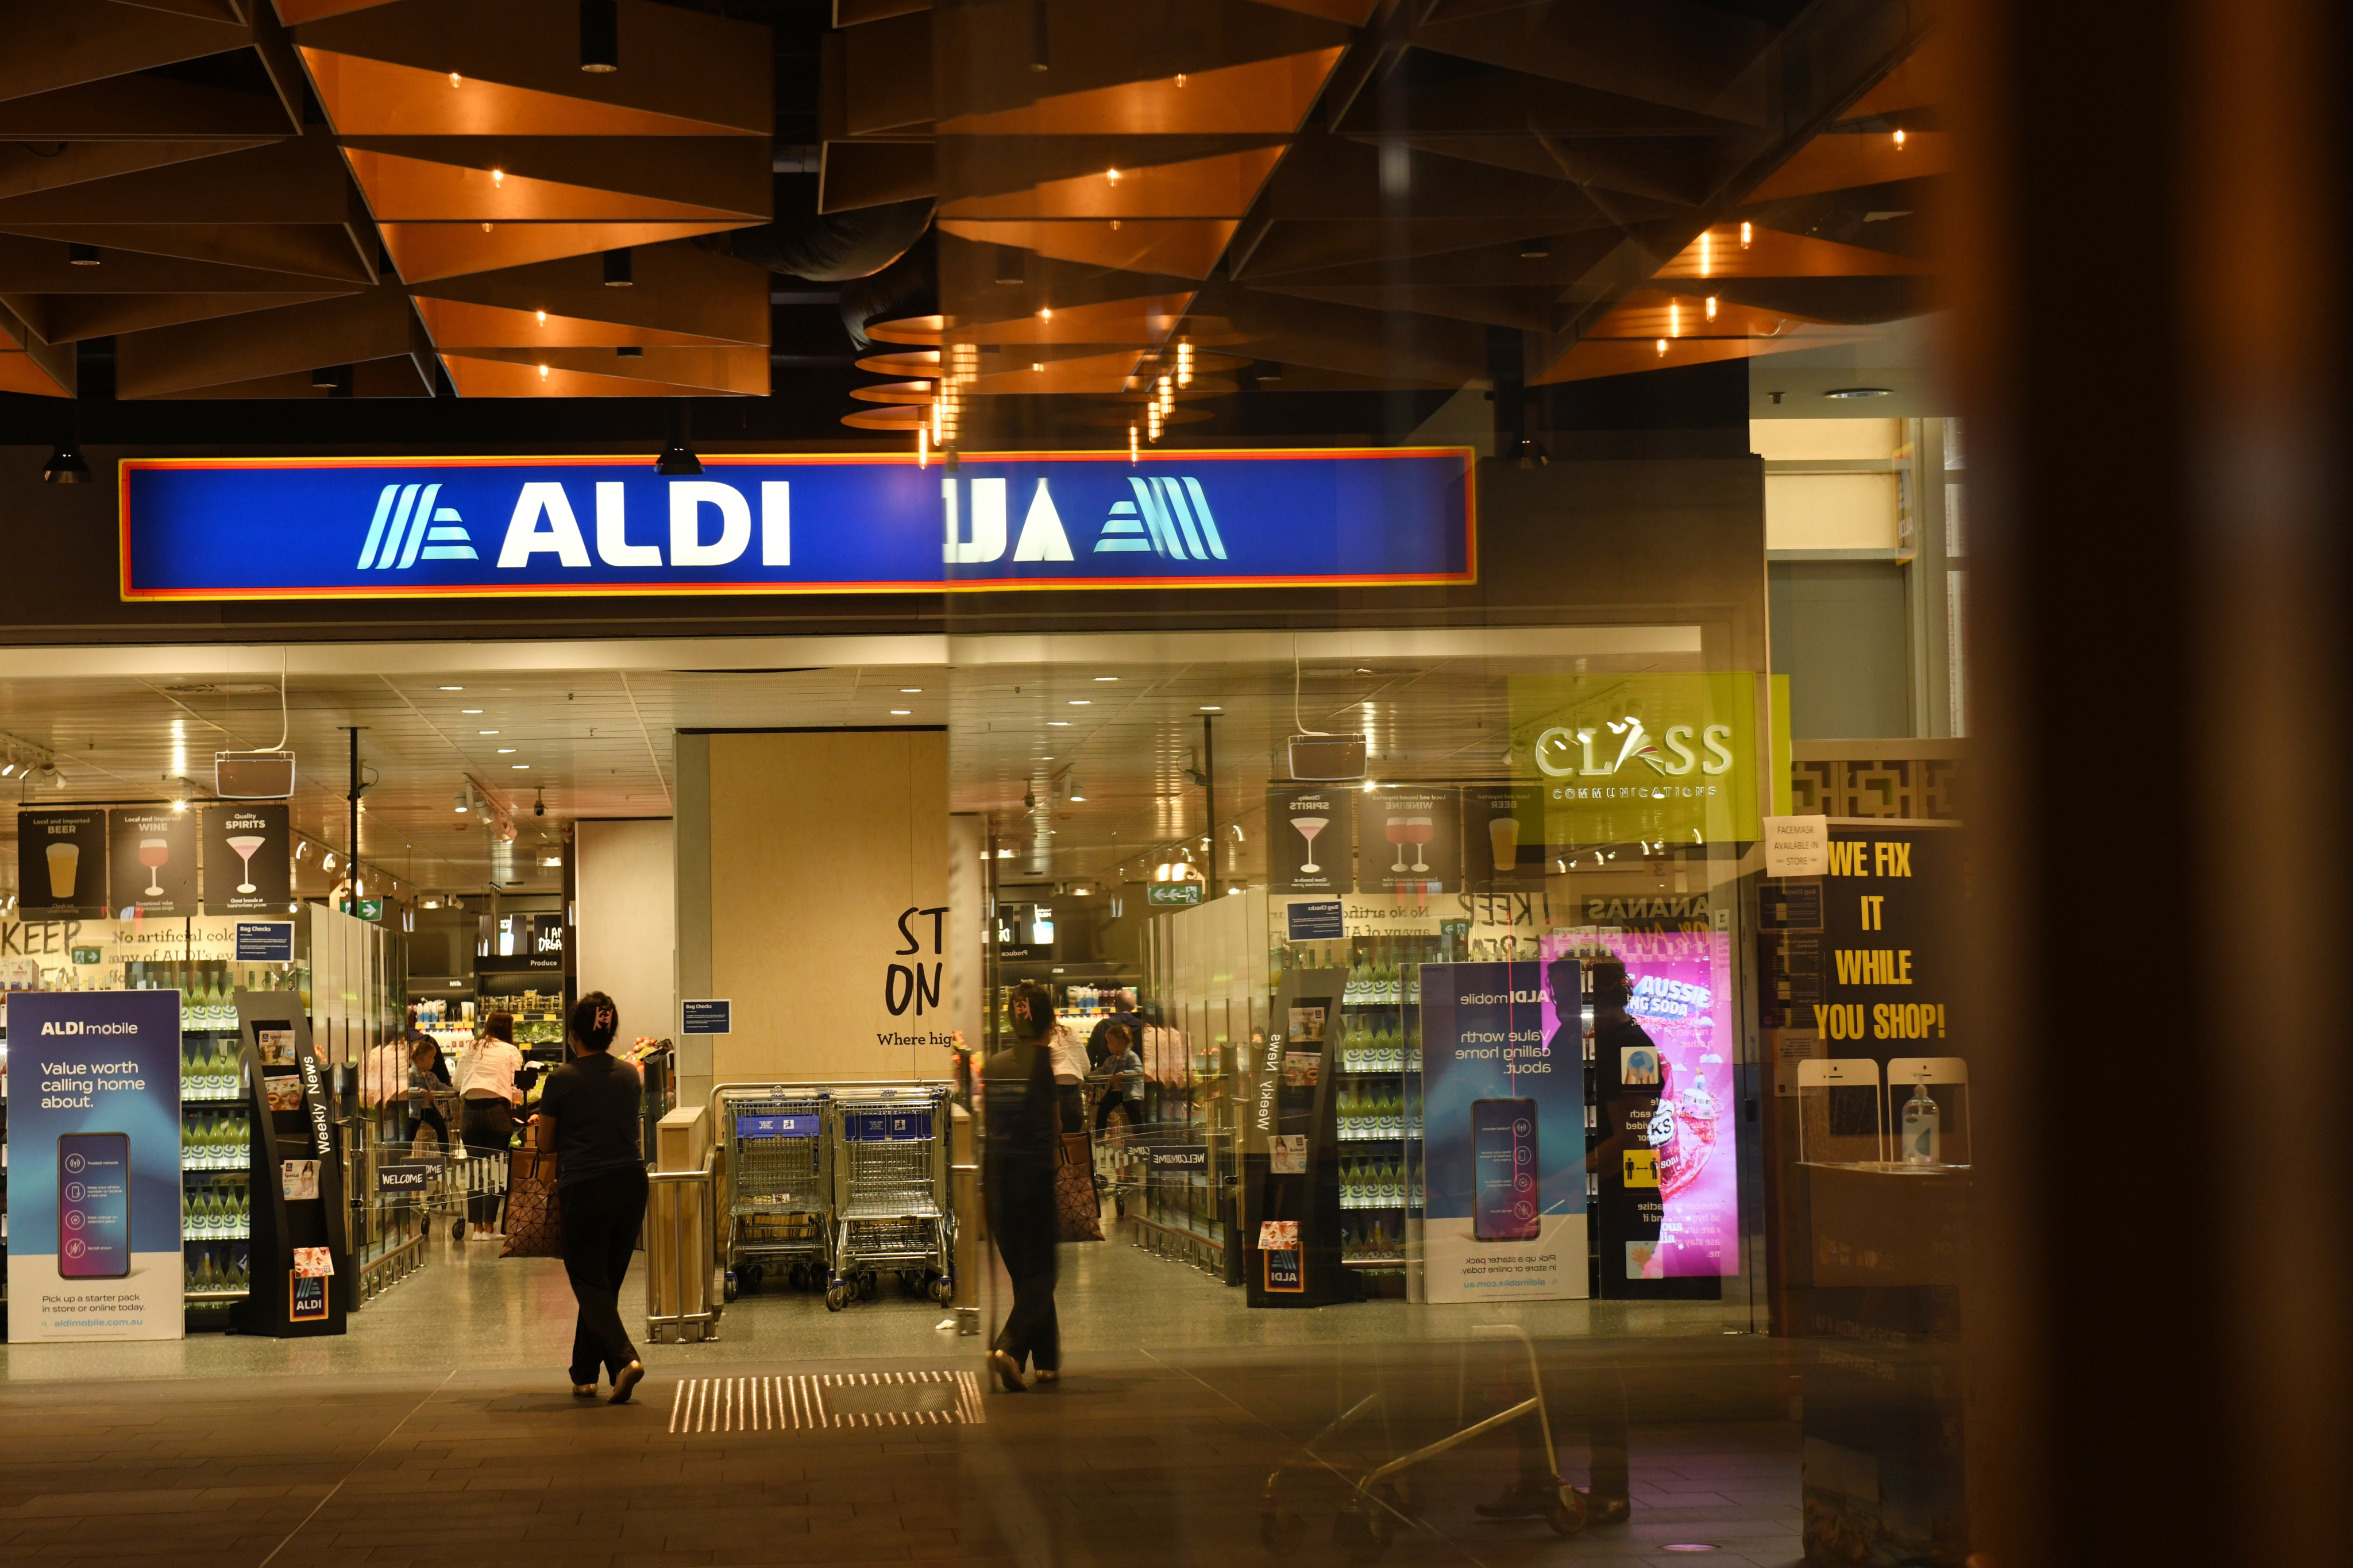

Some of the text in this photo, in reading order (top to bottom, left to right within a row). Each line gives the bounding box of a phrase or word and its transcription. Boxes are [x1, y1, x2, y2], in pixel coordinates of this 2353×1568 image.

[497, 480, 791, 567] ALDI
[1536, 724, 1733, 777] CLASS
[1553, 786, 1716, 800] COMMUNICATIONS
[139, 823, 168, 831] WINE
[226, 820, 265, 829] SPIRITS
[1777, 825, 1814, 835] FACEMASK
[1774, 842, 1808, 850] AVAILABLE
[1786, 857, 1808, 865] STORE
[1827, 841, 1912, 877] WE FIX
[1861, 895, 1884, 930] IT
[1, 919, 82, 956] KEEP
[113, 930, 133, 943] No
[138, 928, 202, 943] artificial
[1835, 950, 1912, 984] WHILE
[885, 962, 942, 1015] ON
[1641, 975, 1711, 1007] AUSSIE
[1651, 998, 1688, 1017] SODA
[1813, 1004, 1865, 1040] YOU
[1873, 1003, 1945, 1038] SHOP!
[877, 1032, 925, 1045] Where
[41, 1061, 138, 1075] Value worth
[41, 1078, 145, 1094] calling home
[41, 1096, 93, 1108] about.
[304, 1056, 330, 1154] Weekly News
[383, 1174, 423, 1184] WELCOME
[64, 1296, 75, 1304] up
[118, 1294, 140, 1302] pack
[296, 1299, 321, 1310] ALDI
[118, 1304, 145, 1312] today.
